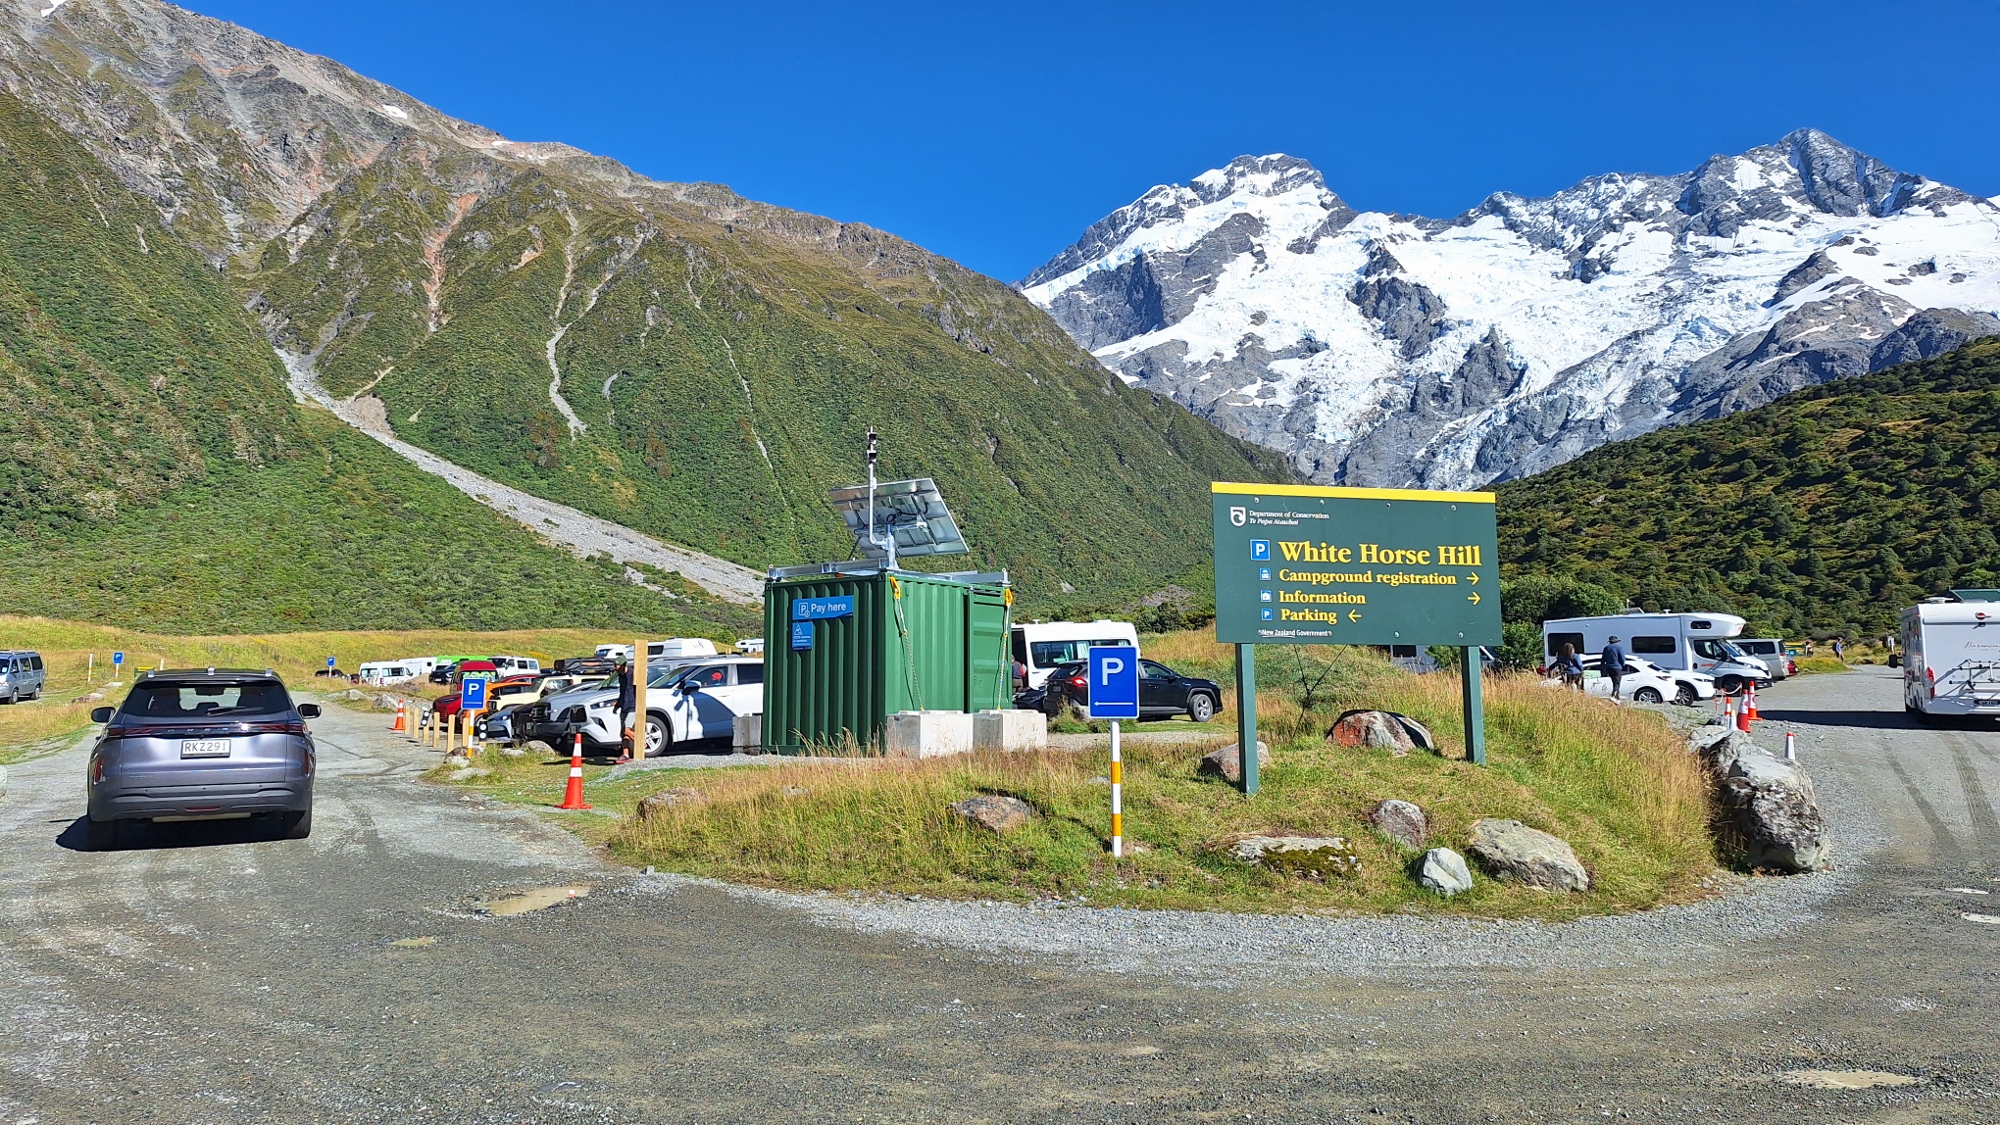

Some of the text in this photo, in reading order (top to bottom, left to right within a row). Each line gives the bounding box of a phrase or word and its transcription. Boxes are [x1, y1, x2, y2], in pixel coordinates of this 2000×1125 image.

[1249, 510, 1283, 518] Department
[1292, 511, 1330, 519] Conservation
[1255, 543, 1266, 556] P
[1278, 540, 1482, 566] White Horse Hill
[1279, 568, 1457, 587] Campground registration
[1279, 589, 1367, 604] Information
[811, 602, 847, 614] Pay here
[1281, 608, 1338, 625] Parking
[1101, 657, 1124, 686] P
[468, 683, 480, 696] P
[184, 742, 227, 752] RKZ291
